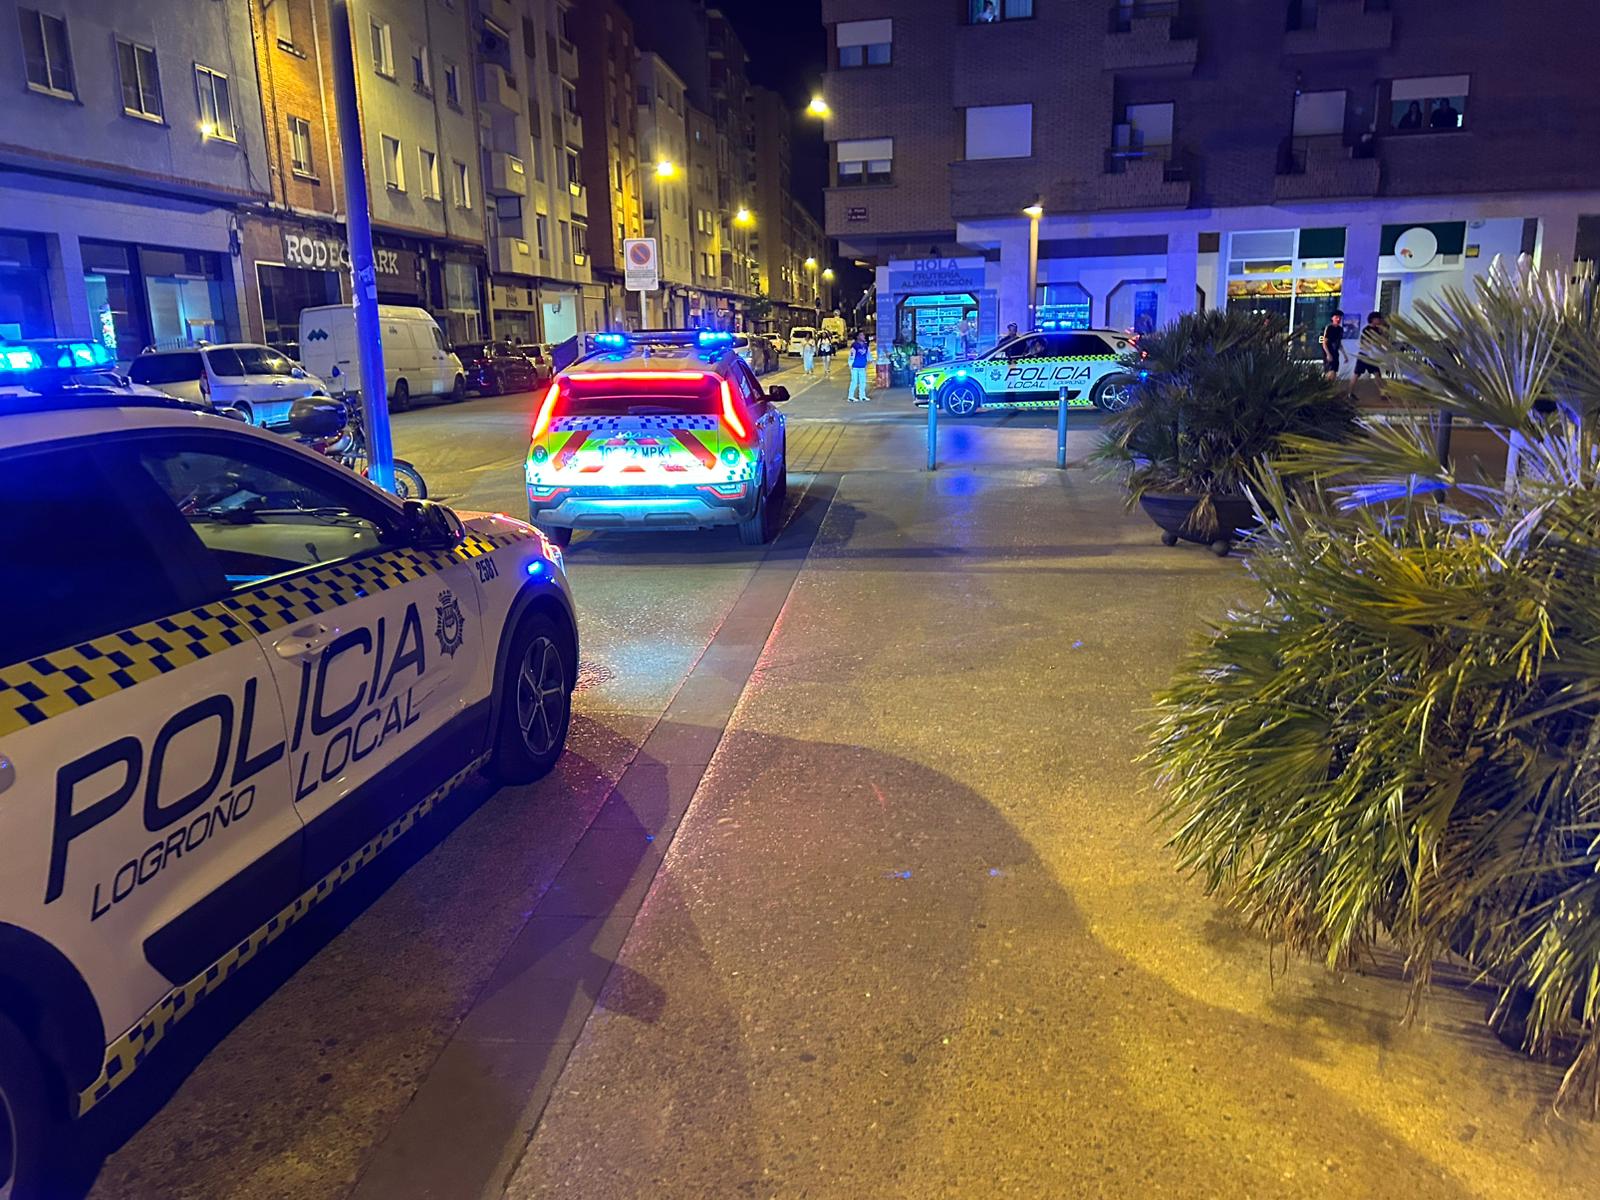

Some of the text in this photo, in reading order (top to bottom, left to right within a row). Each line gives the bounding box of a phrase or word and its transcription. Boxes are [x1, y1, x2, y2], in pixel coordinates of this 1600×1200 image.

[913, 258, 959, 271] HOLA
[1004, 366, 1091, 381] POLICIA
[1007, 381, 1046, 389] LOCAL
[475, 556, 499, 583] 2581
[44, 602, 426, 904] POLICIA
[294, 687, 421, 803] LOCAL
[90, 784, 255, 922] LOGROÑO
